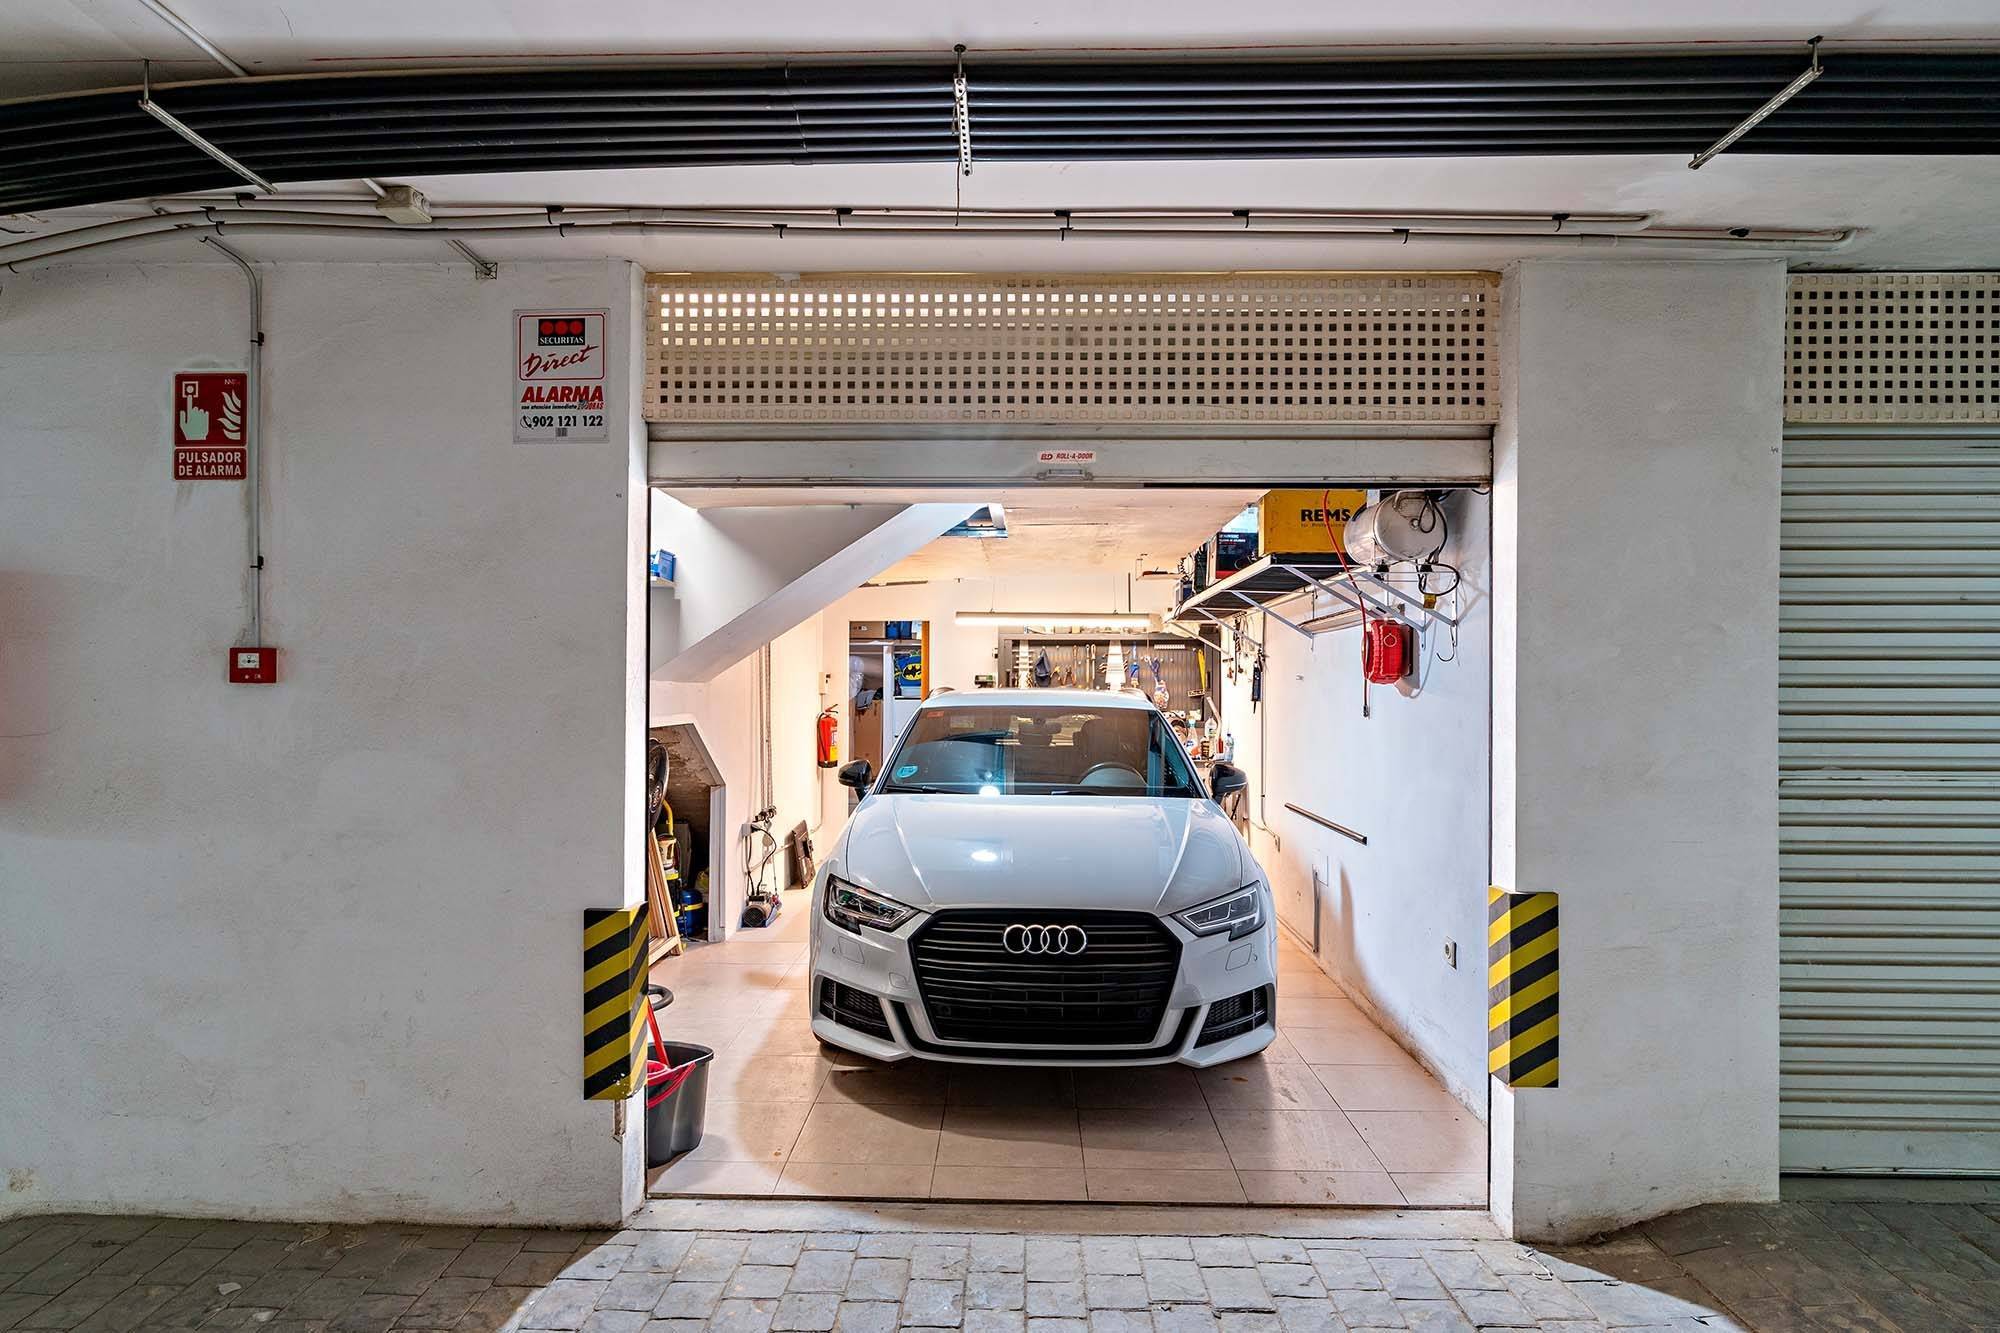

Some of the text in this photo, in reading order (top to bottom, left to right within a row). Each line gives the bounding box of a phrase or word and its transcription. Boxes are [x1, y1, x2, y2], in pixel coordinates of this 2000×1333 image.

[539, 336, 584, 345] SECURITAS
[523, 344, 599, 377] Direct
[520, 385, 604, 403] ALARMA
[532, 415, 603, 427] 902 121 122
[178, 452, 242, 463] PULSADOR
[178, 465, 242, 476] DE ALARMA
[1300, 509, 1351, 522] REMS
